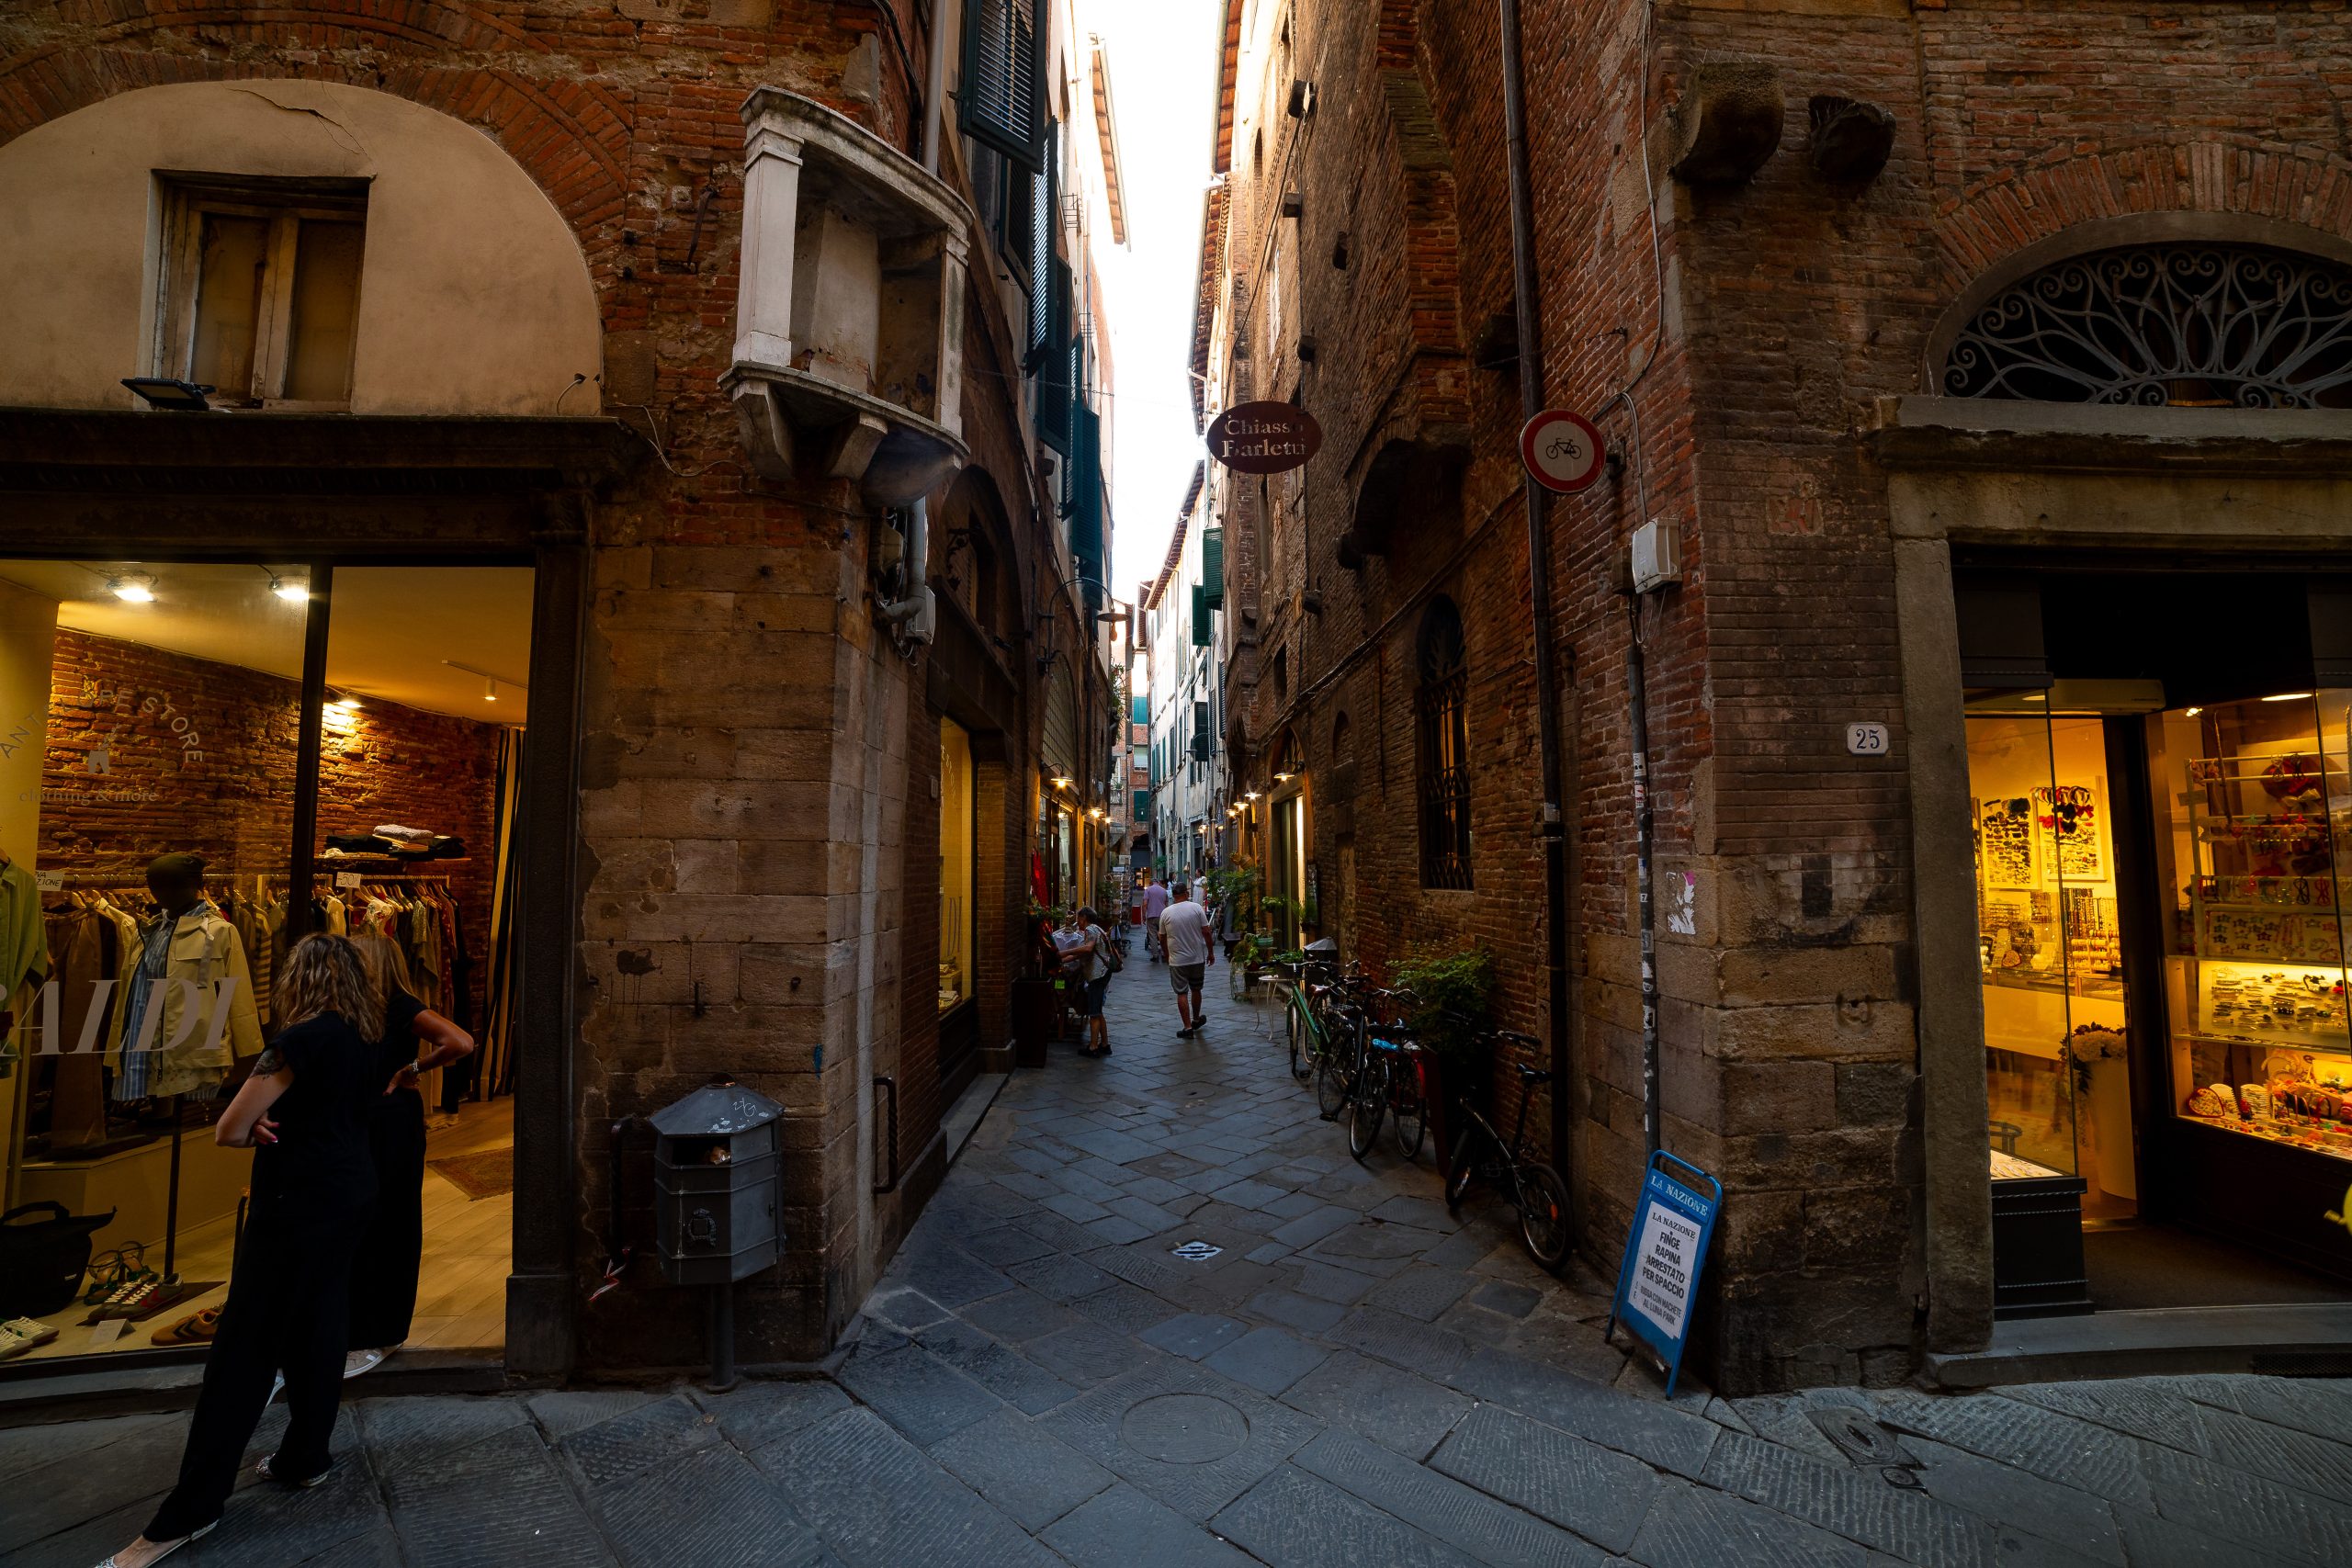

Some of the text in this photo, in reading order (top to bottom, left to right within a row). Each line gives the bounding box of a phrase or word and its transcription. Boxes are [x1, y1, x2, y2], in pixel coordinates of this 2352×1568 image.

[141, 696, 203, 763] STORE
[1856, 728, 1880, 750] 25
[18, 787, 159, 807] clothing & more
[0, 976, 242, 1056] ALDI
[1651, 1175, 1708, 1216] LA NAZIONE
[1652, 1212, 1696, 1239] LA NAZIONE
[1659, 1231, 1681, 1250] FINGE
[1645, 1254, 1686, 1283] ARRESTATO
[1655, 1244, 1681, 1267] RAPINA
[1643, 1266, 1655, 1282] PER
[1654, 1274, 1685, 1299] SPACCIO
[1643, 1298, 1677, 1325] AL LUNA PARK
[1652, 1293, 1662, 1304] CON
[1662, 1298, 1682, 1318] MACHETE
